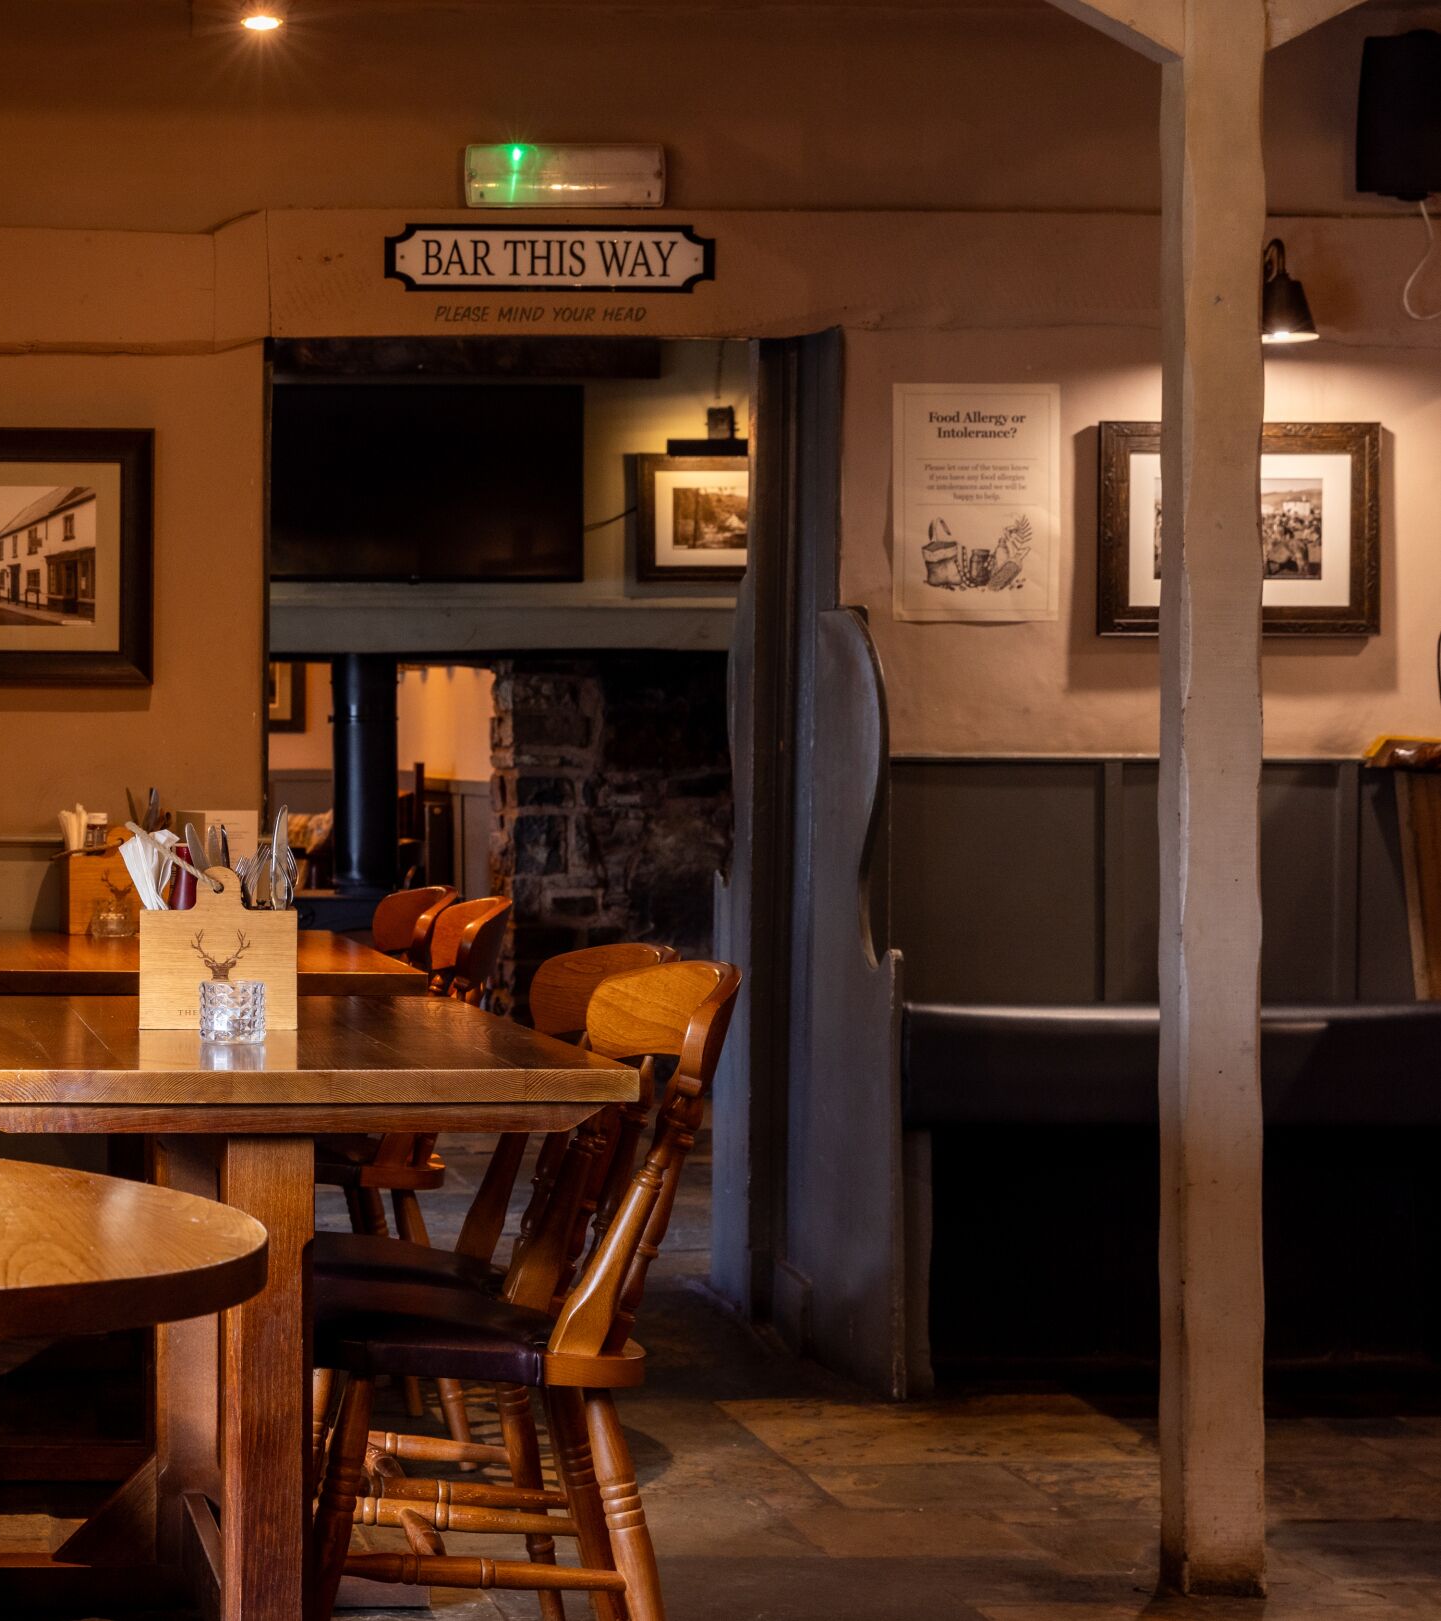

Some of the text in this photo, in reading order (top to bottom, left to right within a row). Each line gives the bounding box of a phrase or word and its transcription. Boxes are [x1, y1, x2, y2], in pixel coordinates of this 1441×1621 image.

[421, 239, 679, 277] BAR THIS WAY
[434, 305, 648, 322] PLEASE MIND YOUR HEAD
[928, 411, 1027, 426] Food Allergy or
[937, 427, 1018, 438] Intolerance?
